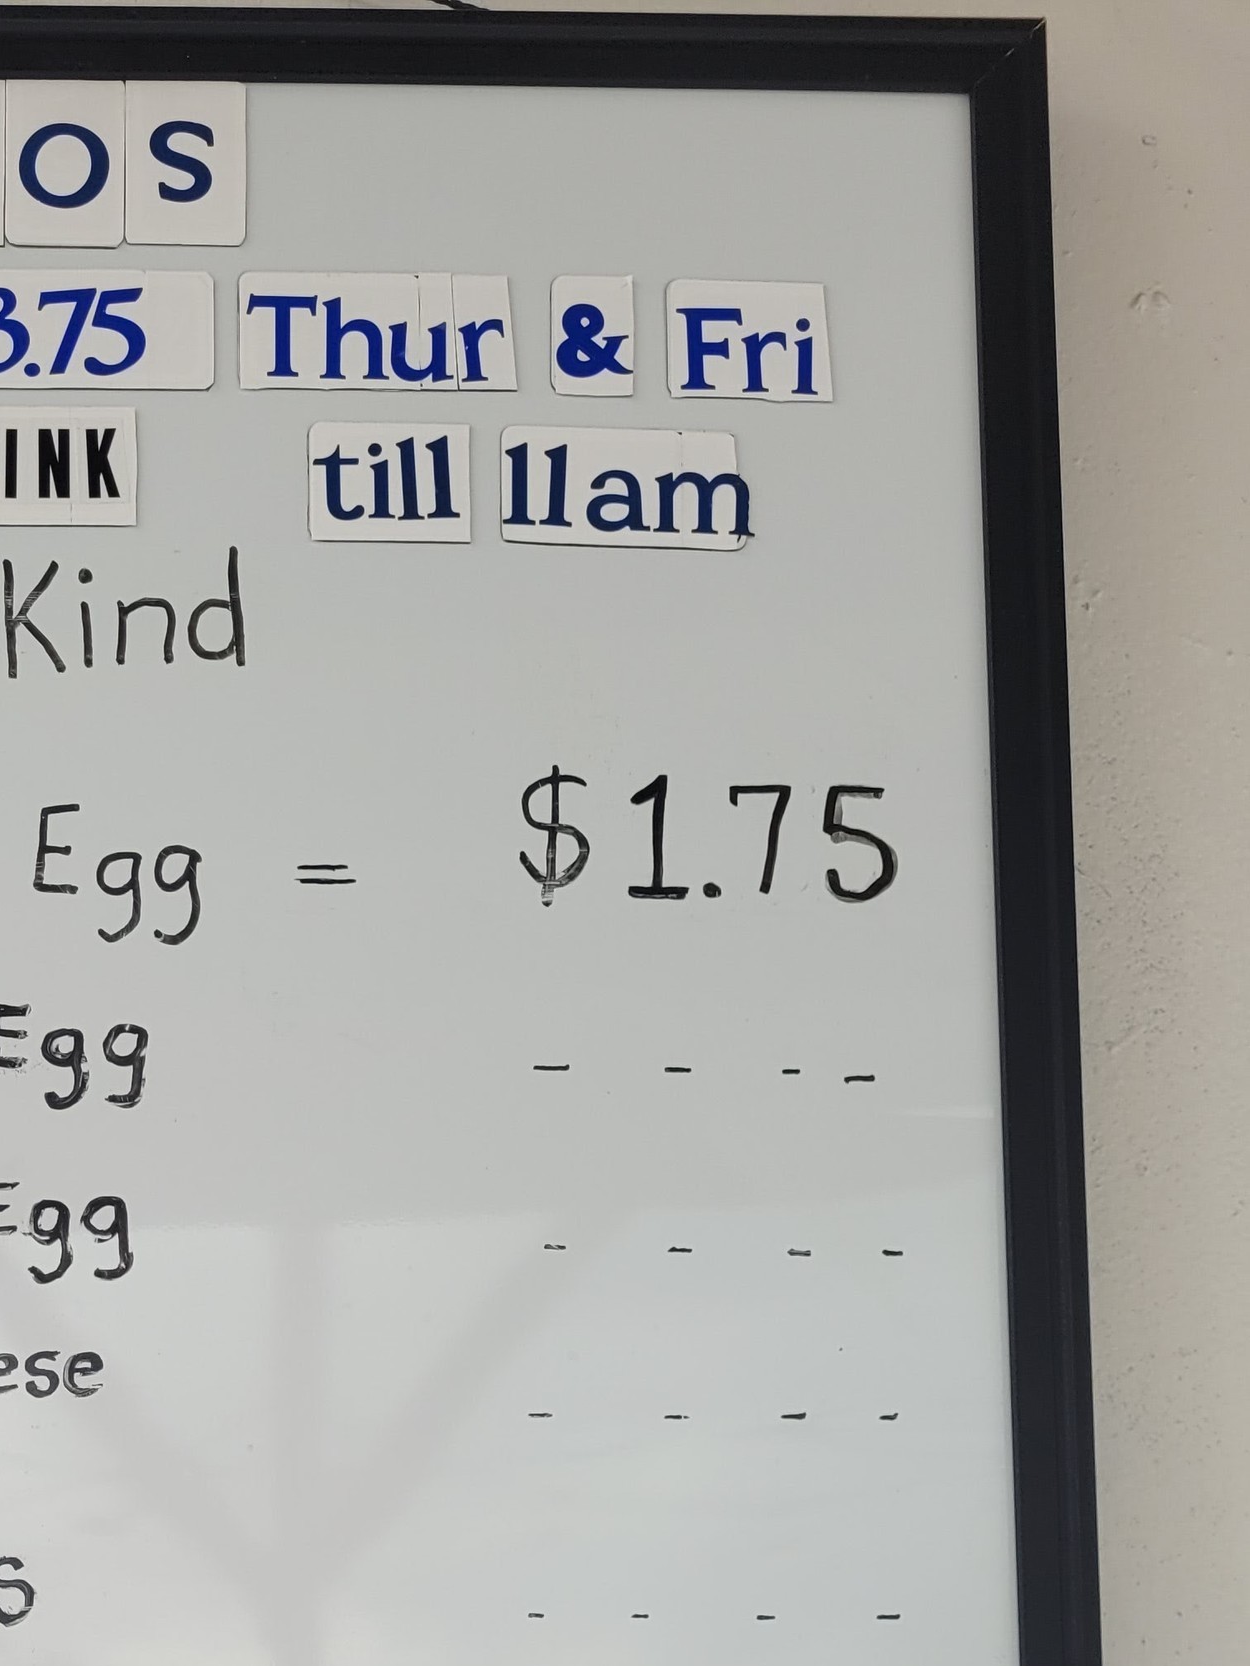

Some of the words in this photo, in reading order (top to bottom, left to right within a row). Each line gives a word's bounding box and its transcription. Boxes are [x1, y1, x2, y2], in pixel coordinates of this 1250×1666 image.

[245, 292, 506, 384] Thur
[554, 302, 635, 379] &
[674, 306, 820, 397] Fri
[311, 434, 462, 522] till
[1, 544, 247, 680] Kind
[31, 802, 204, 947] Egg
[518, 763, 899, 904] $1.75
